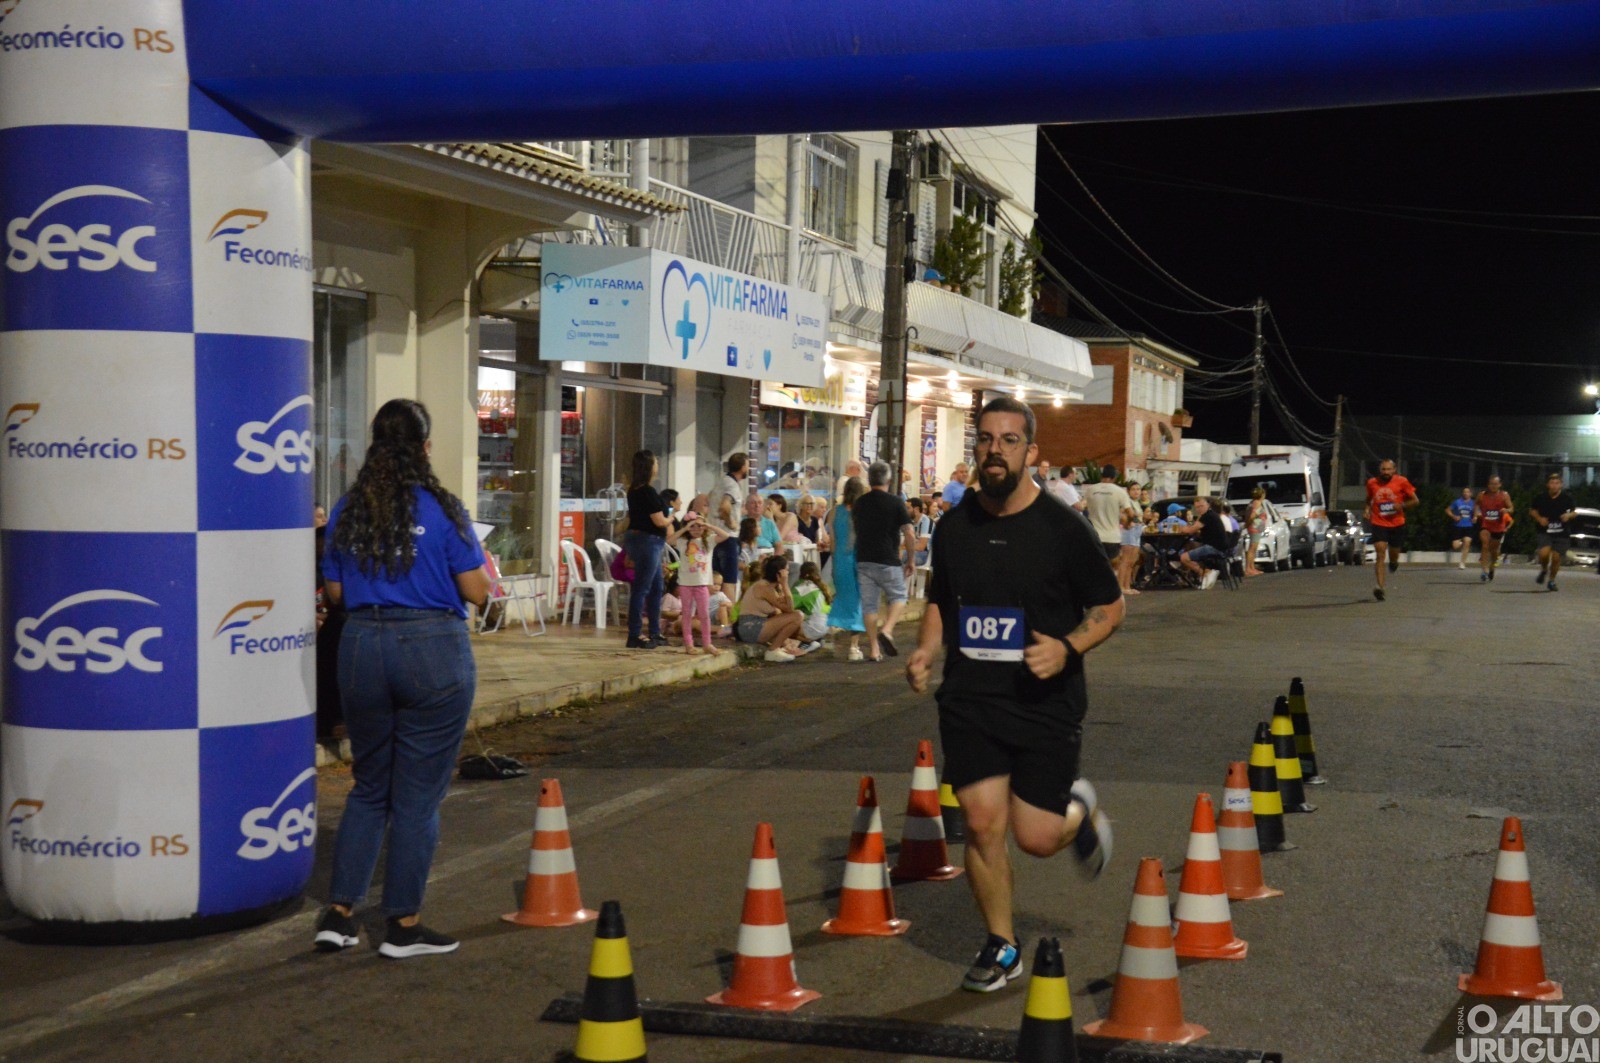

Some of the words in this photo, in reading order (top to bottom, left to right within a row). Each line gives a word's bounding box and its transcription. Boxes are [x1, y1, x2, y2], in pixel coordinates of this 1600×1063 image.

[134, 28, 175, 54] RS
[574, 277, 645, 291] VITAFARMA
[709, 271, 788, 321] VITAFARMA
[8, 436, 138, 460] Fecomércio
[147, 438, 187, 461] RS
[965, 616, 1017, 640] 087
[12, 829, 140, 858] Fecomércio
[150, 835, 190, 857] RS
